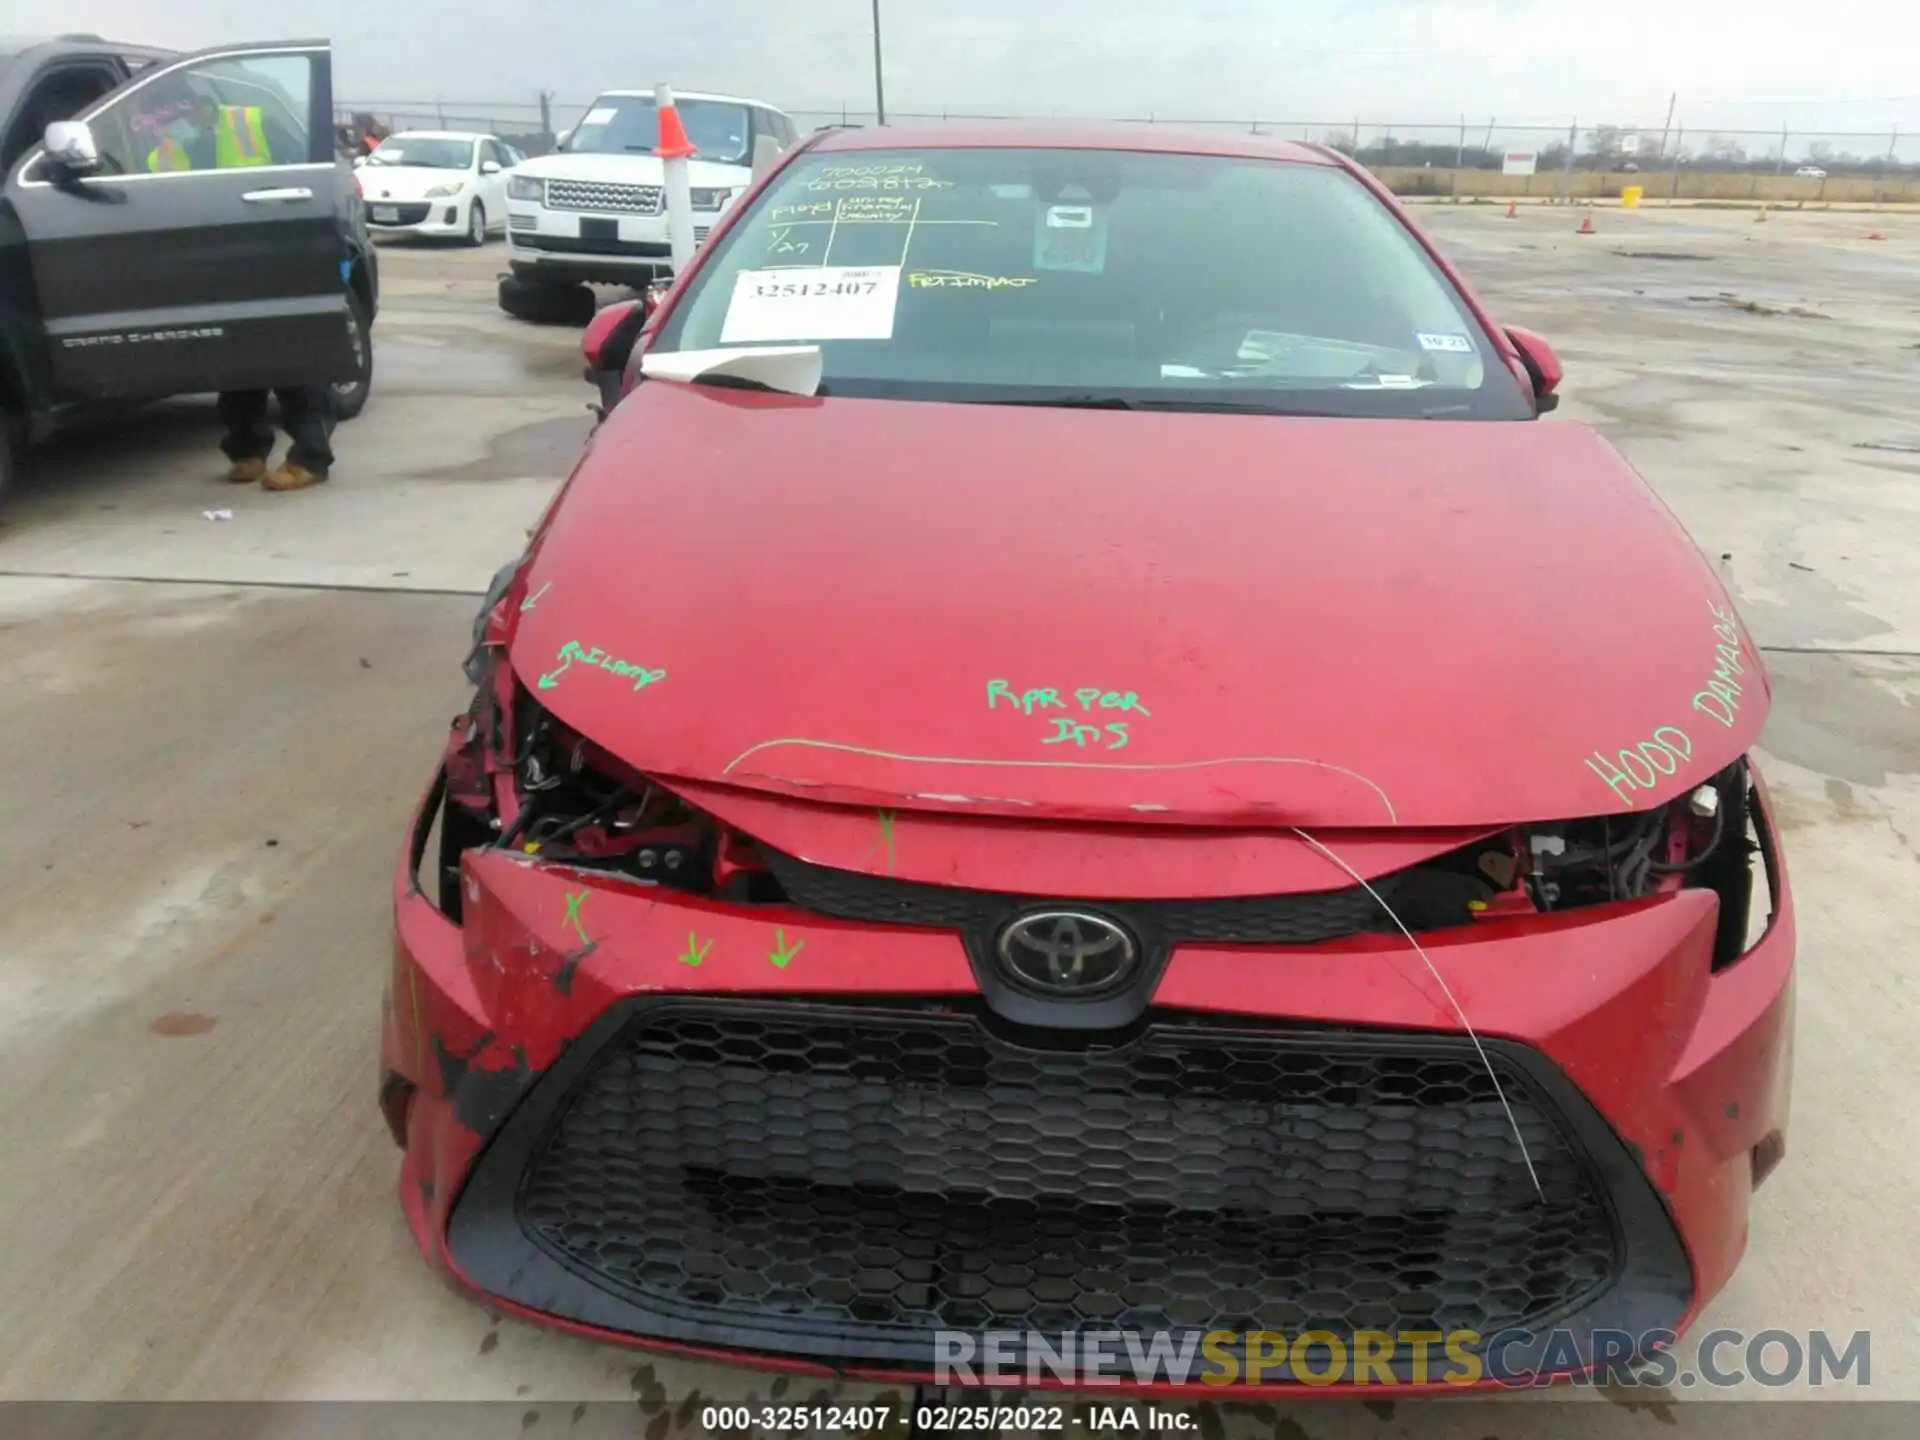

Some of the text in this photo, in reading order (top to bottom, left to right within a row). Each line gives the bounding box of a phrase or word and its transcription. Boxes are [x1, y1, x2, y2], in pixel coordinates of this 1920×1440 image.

[750, 282, 877, 298] 32512407
[1584, 599, 1744, 806] HOOD DAMAGE
